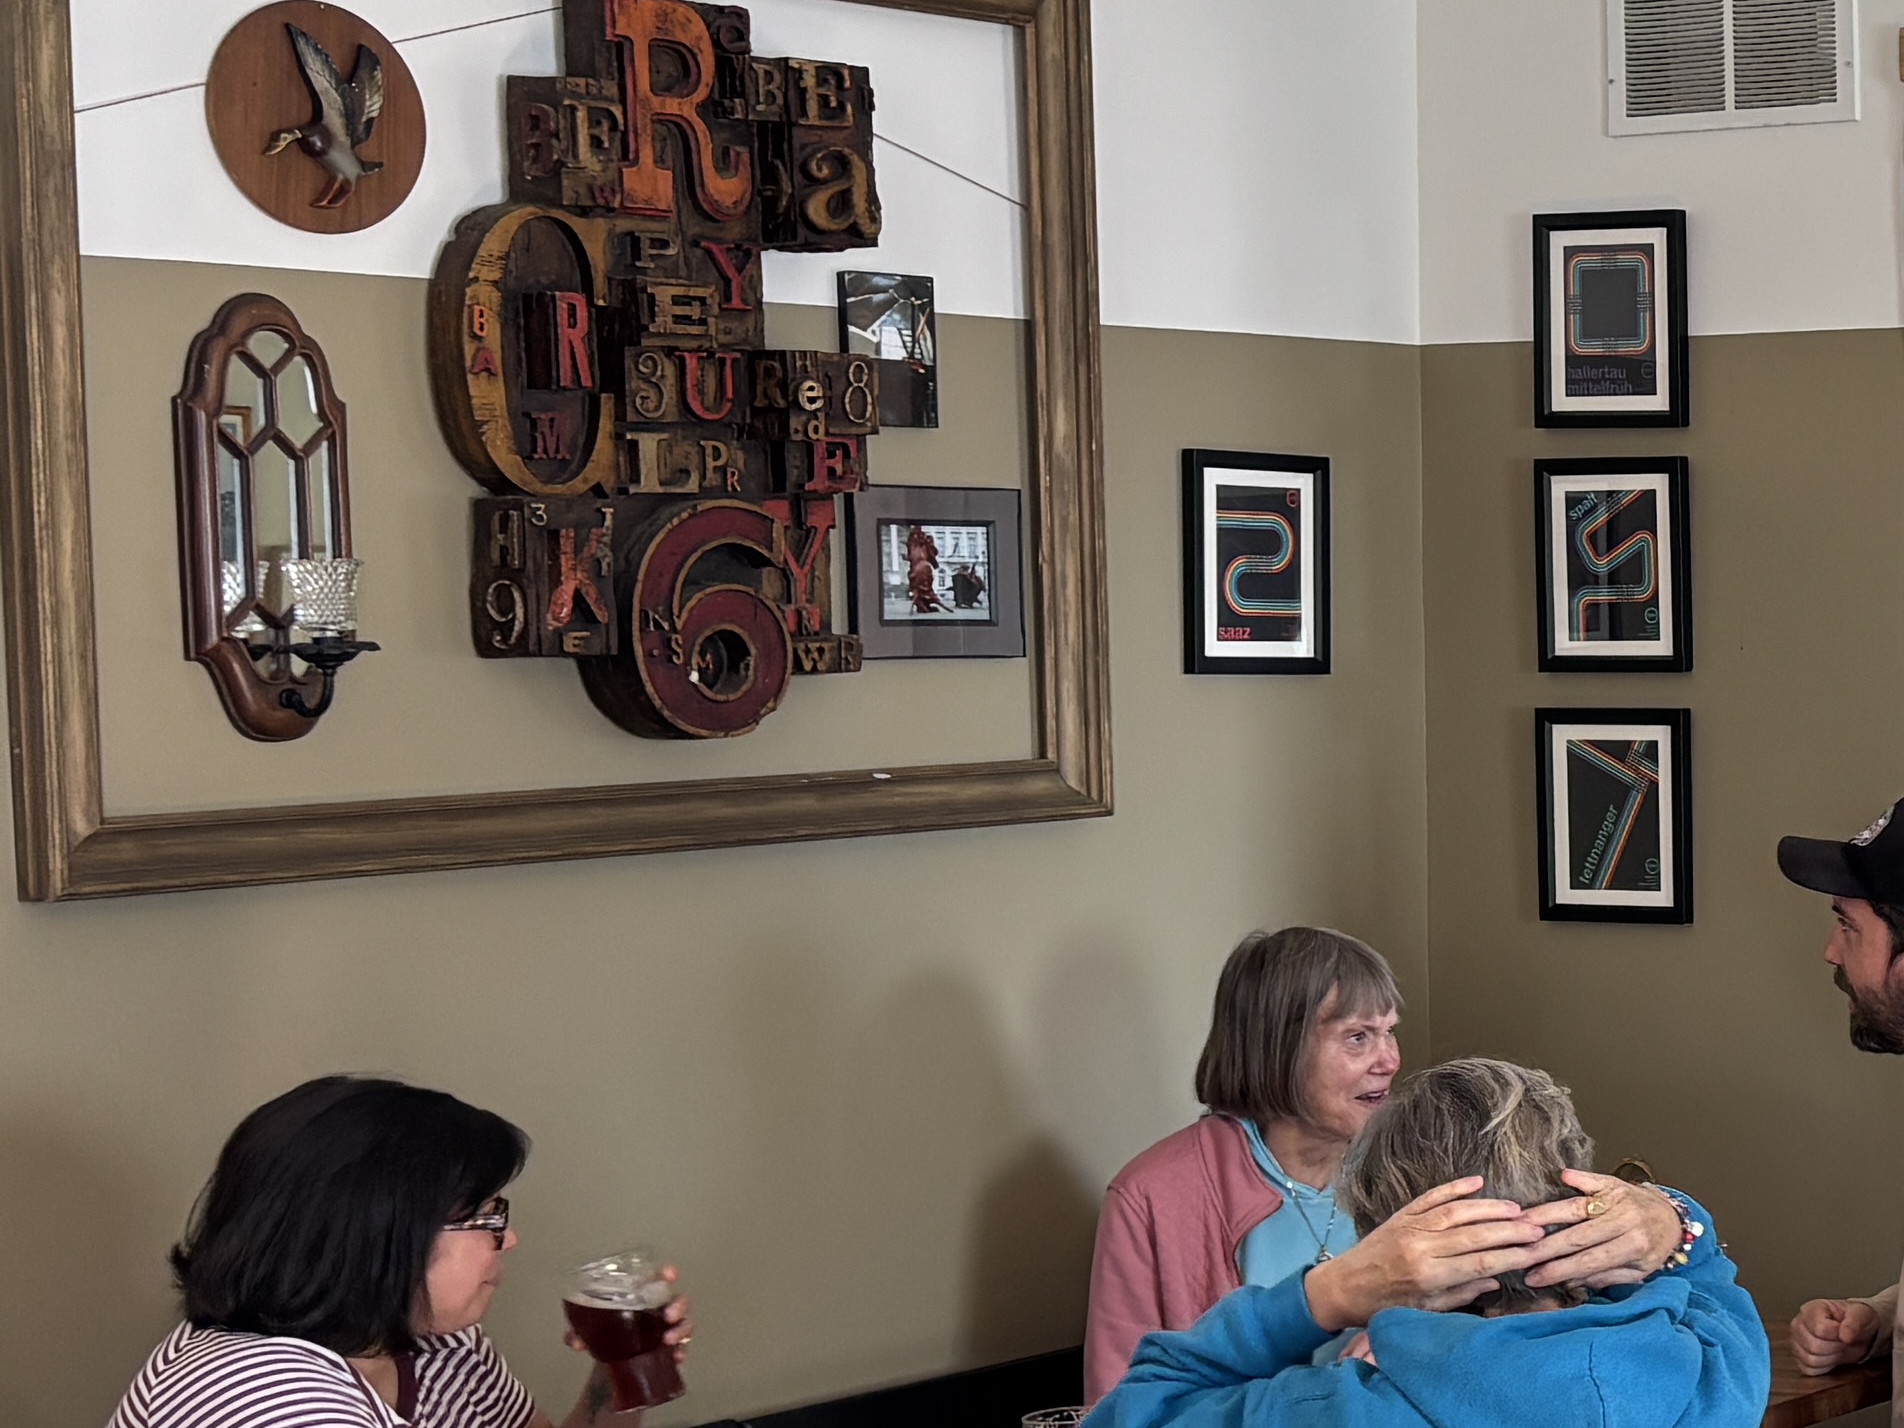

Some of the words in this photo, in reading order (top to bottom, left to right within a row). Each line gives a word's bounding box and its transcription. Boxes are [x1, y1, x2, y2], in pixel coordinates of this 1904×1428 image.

[754, 63, 786, 112] B
[788, 59, 854, 127] E
[804, 147, 884, 240] a
[628, 232, 679, 269] P
[696, 240, 762, 311] Y
[472, 305, 490, 338] B
[648, 285, 719, 335] E
[471, 347, 498, 376] A
[555, 291, 592, 388] R
[635, 352, 668, 419] 3
[674, 351, 742, 421] U
[753, 359, 788, 409] R
[798, 379, 825, 411] e
[844, 360, 873, 423] 8
[530, 411, 571, 461] M
[807, 412, 826, 440] d
[624, 432, 699, 494] L
[700, 440, 730, 487] P
[726, 466, 742, 492] R
[804, 436, 862, 493] E
[530, 503, 548, 526] 3
[1569, 492, 1598, 520] spalt
[545, 528, 609, 631] K
[762, 500, 836, 636] Y
[486, 580, 525, 650] 9
[632, 499, 794, 739] 6
[1218, 627, 1251, 640] saaz
[670, 634, 686, 665] S
